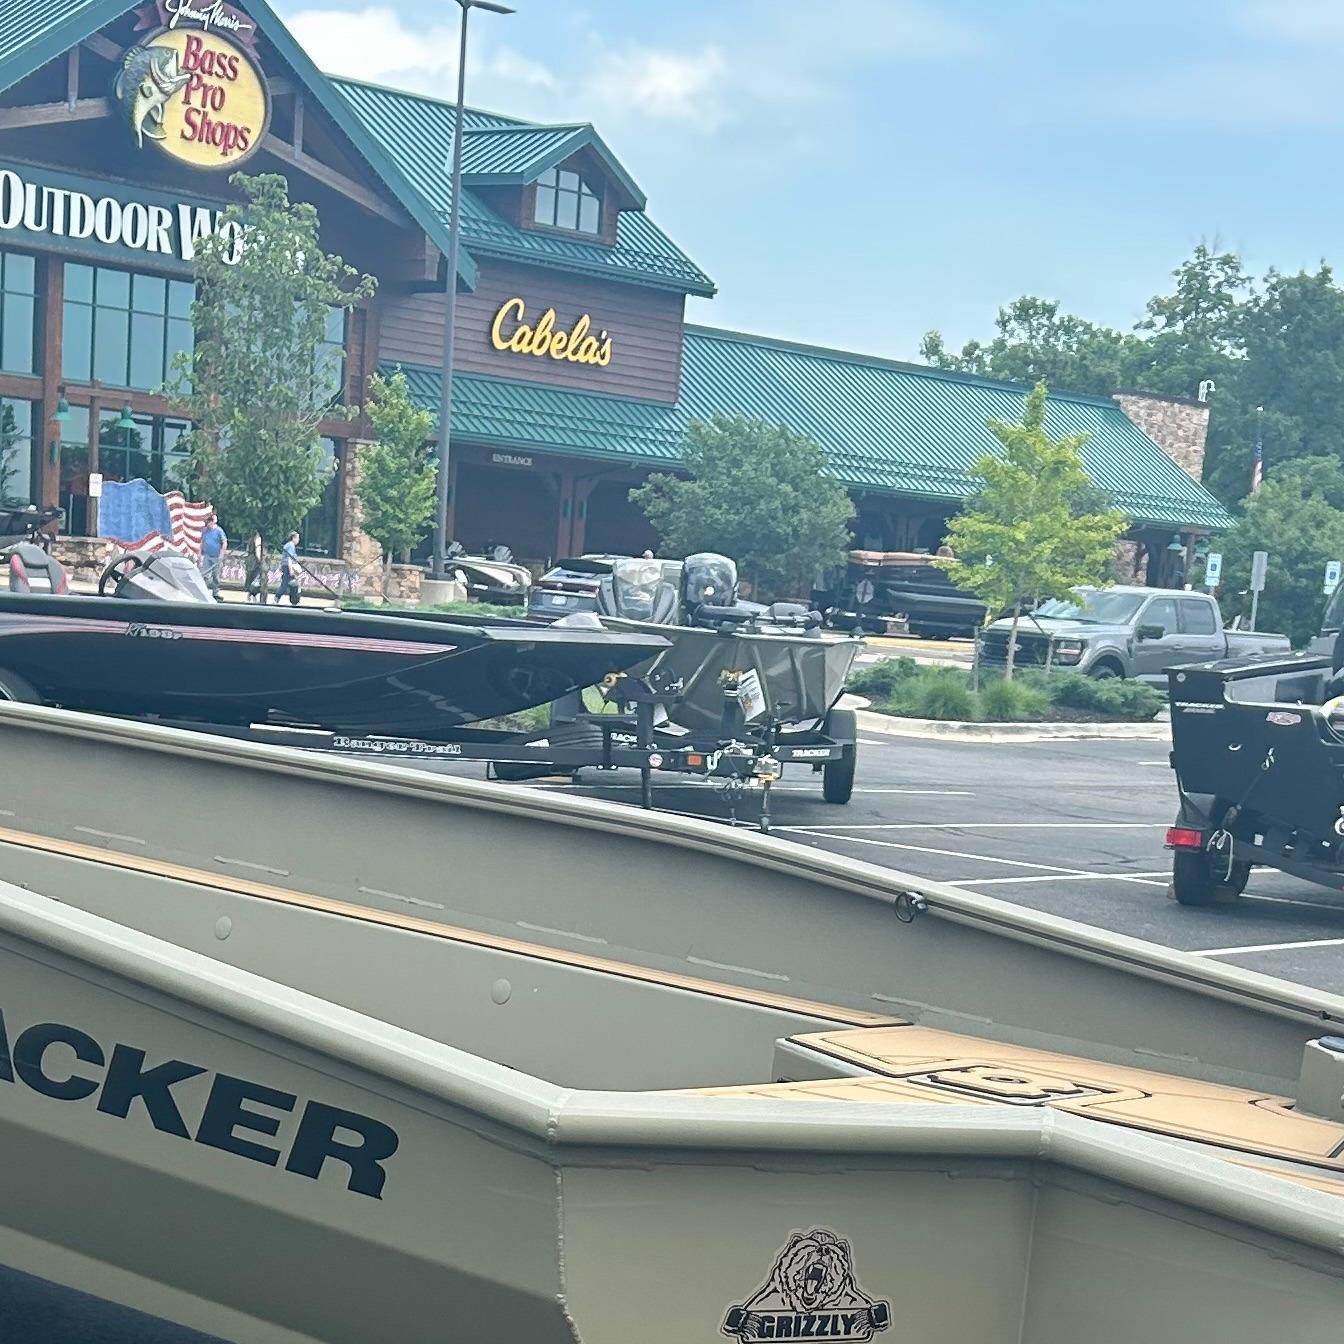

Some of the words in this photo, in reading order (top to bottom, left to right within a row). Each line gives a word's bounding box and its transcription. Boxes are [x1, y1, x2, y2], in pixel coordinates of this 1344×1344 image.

[180, 34, 240, 81] Bass
[181, 73, 227, 112] Pro
[180, 107, 252, 157] Shops
[491, 297, 613, 366] Cabela's
[492, 453, 533, 467] ENTRANCE
[333, 736, 408, 752] Ranger
[791, 748, 831, 758] TRACKER
[758, 1314, 857, 1339] GRIZZLY
